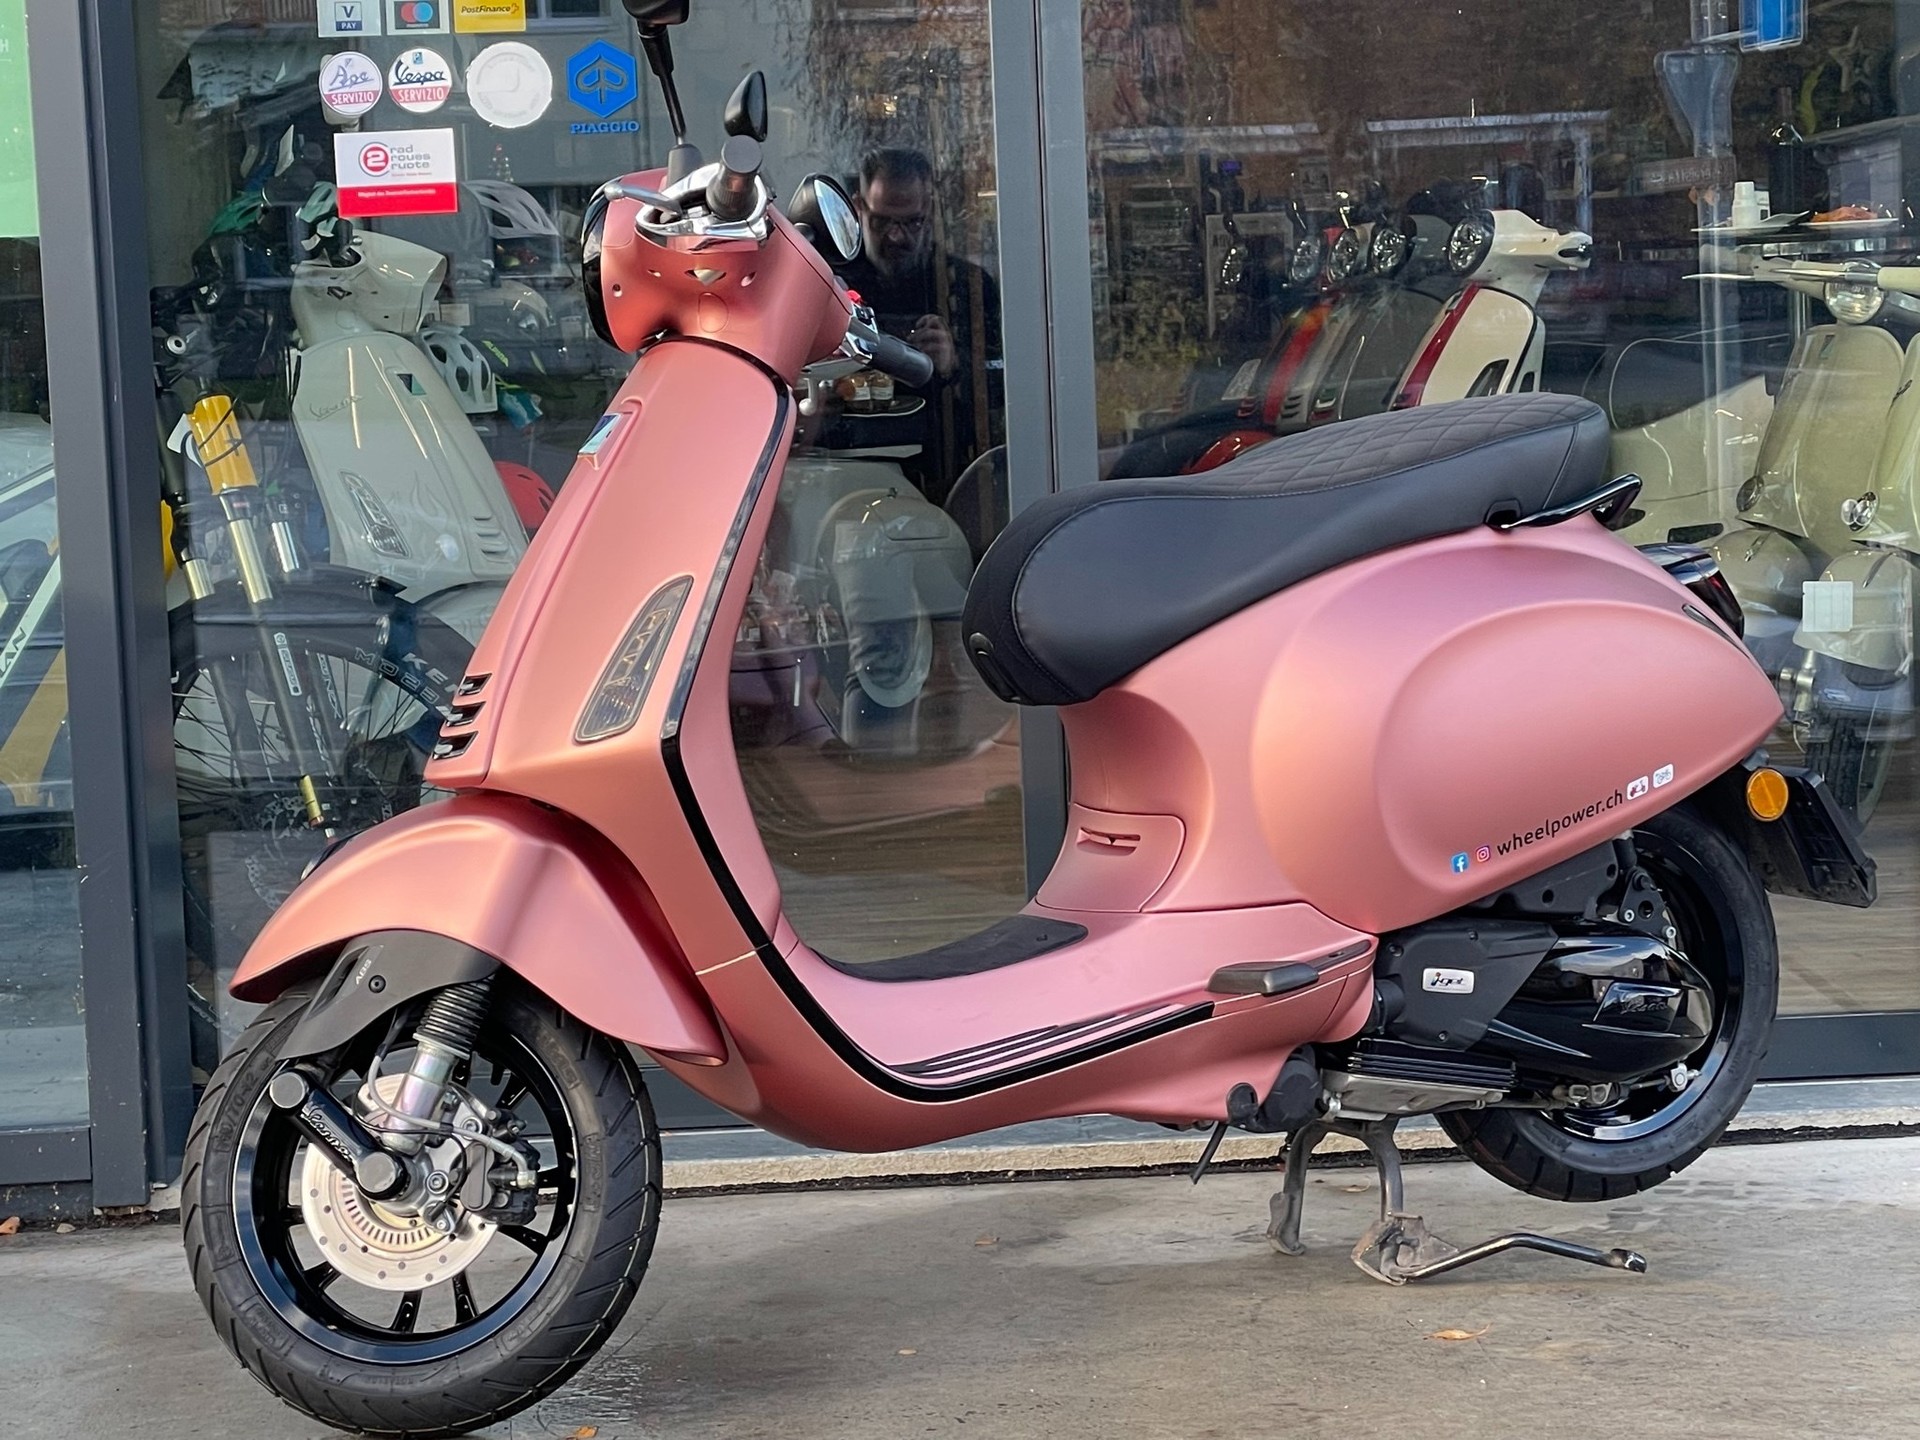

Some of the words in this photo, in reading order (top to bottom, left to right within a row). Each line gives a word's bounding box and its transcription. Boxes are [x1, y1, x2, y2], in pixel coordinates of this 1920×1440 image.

[341, 5, 354, 18] V
[461, 4, 511, 13] PostFinance
[341, 22, 357, 30] PAY
[329, 65, 374, 92] Ape
[393, 60, 447, 85] Vespa
[331, 92, 375, 105] SERVIZIO
[398, 87, 445, 102] SERVIZIO
[570, 121, 640, 134] PIAGGIO
[366, 150, 387, 167] 2
[390, 144, 414, 153] rad
[391, 153, 431, 162] roues
[391, 161, 430, 170] ruote
[1497, 790, 1623, 856] wheelpower.ch
[355, 959, 372, 985] ABS
[301, 1102, 353, 1161] Vespa
